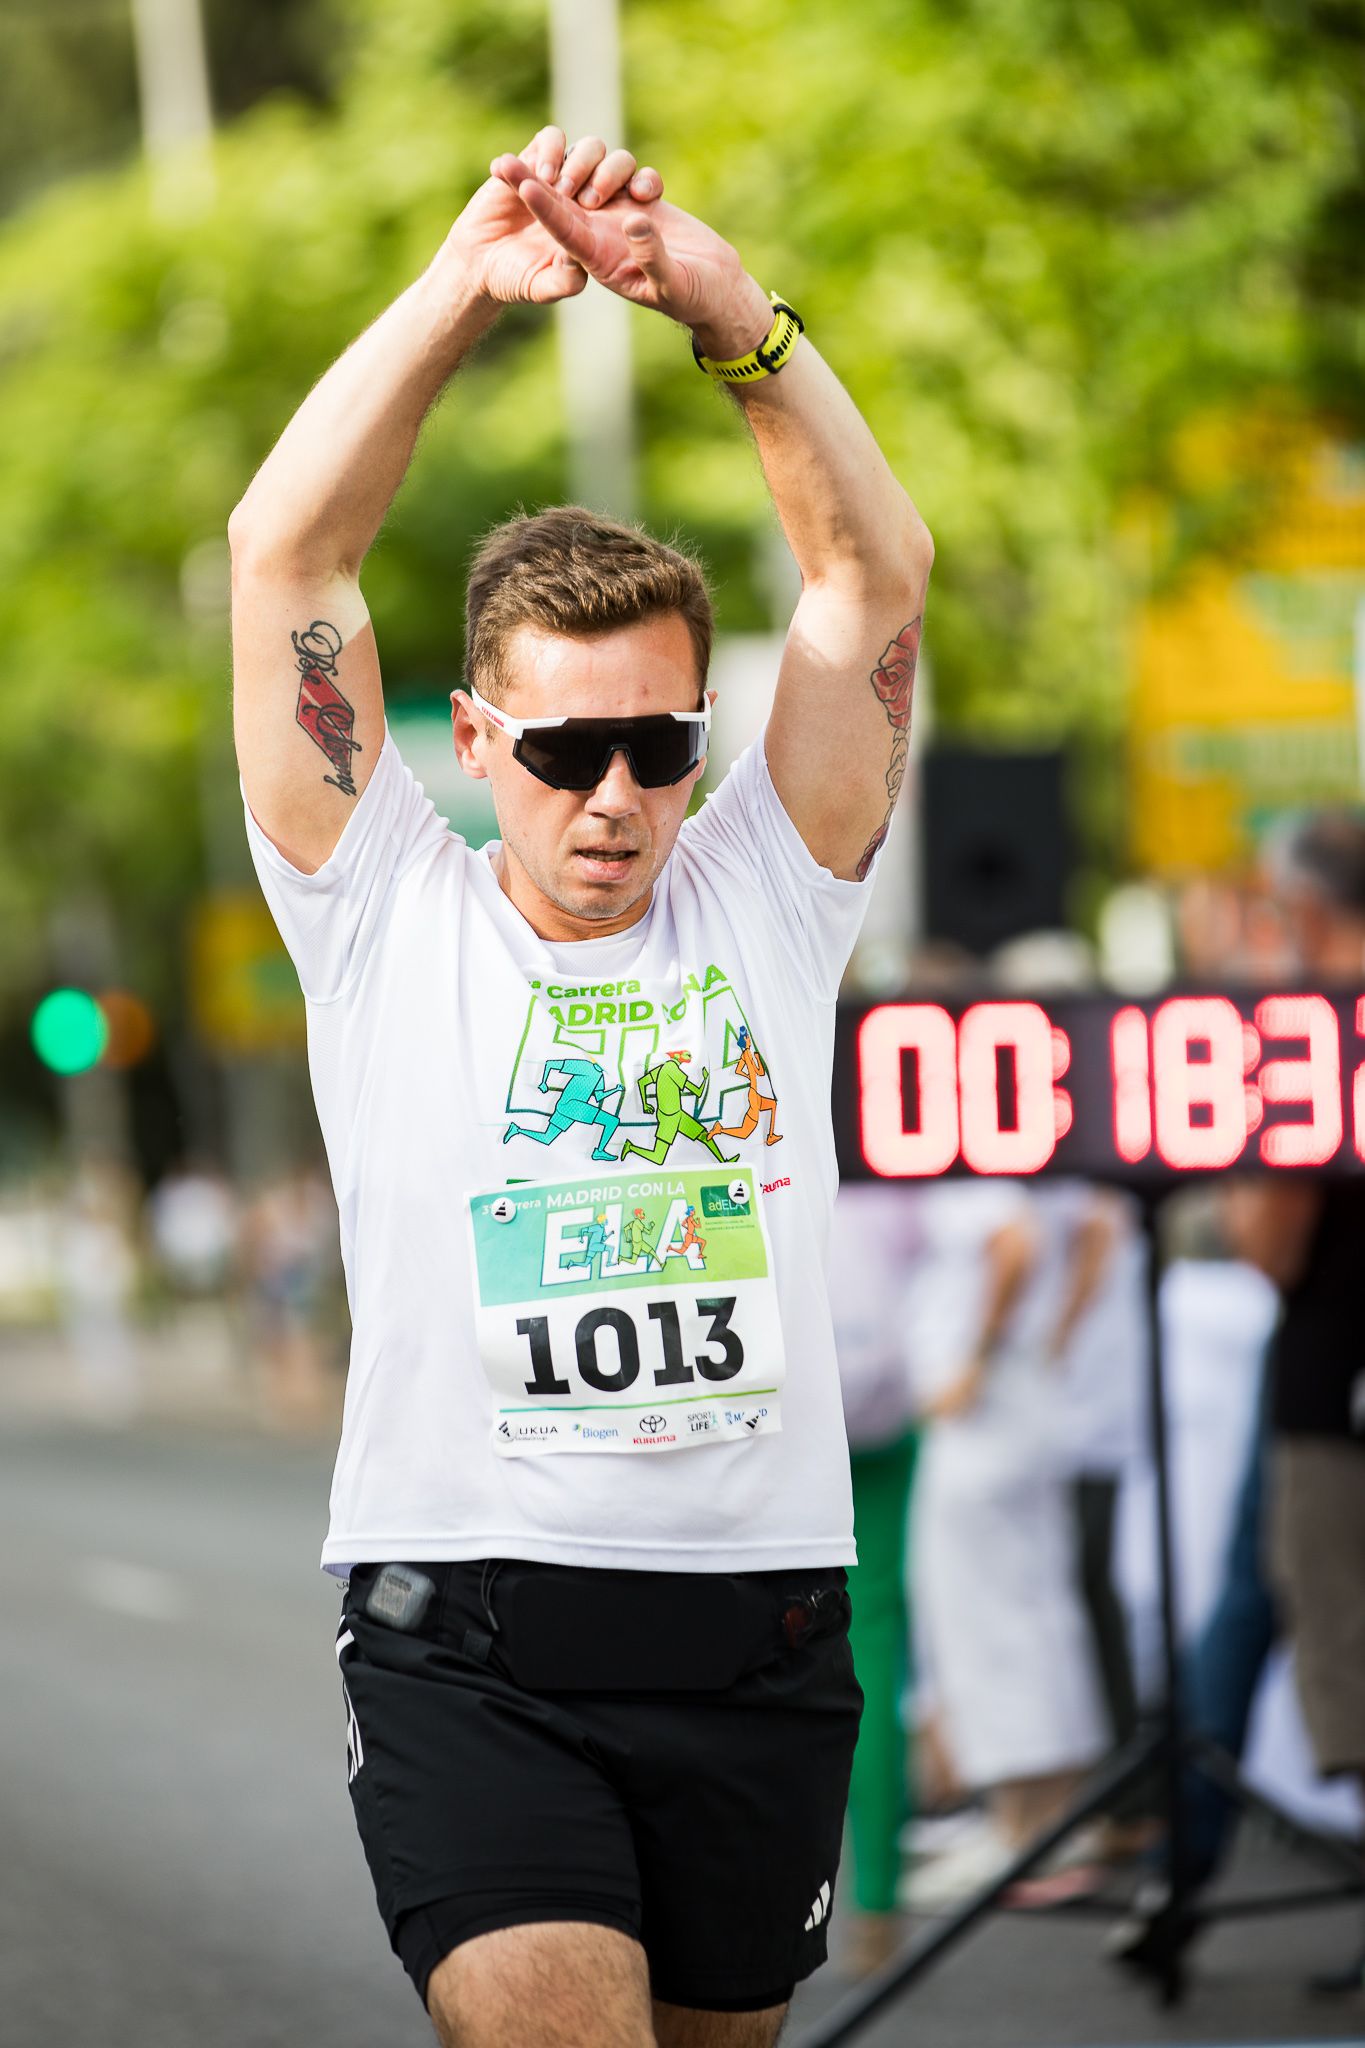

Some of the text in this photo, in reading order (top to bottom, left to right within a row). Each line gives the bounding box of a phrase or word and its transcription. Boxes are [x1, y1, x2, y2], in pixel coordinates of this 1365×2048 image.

[547, 979, 641, 999] Carrera
[548, 1000, 654, 1026] ADRID
[702, 963, 728, 991] A
[857, 994, 1365, 1177] 00:18:3
[481, 1204, 492, 1216] 3
[547, 1187, 622, 1209] MADRID
[627, 1182, 663, 1197] CON
[667, 1181, 686, 1195] LA
[540, 1198, 706, 1287] ELA
[516, 1296, 744, 1395] 1013
[582, 1426, 619, 1440] Biogen
[687, 1411, 711, 1422] SPORT
[691, 1421, 710, 1432] LIFE
